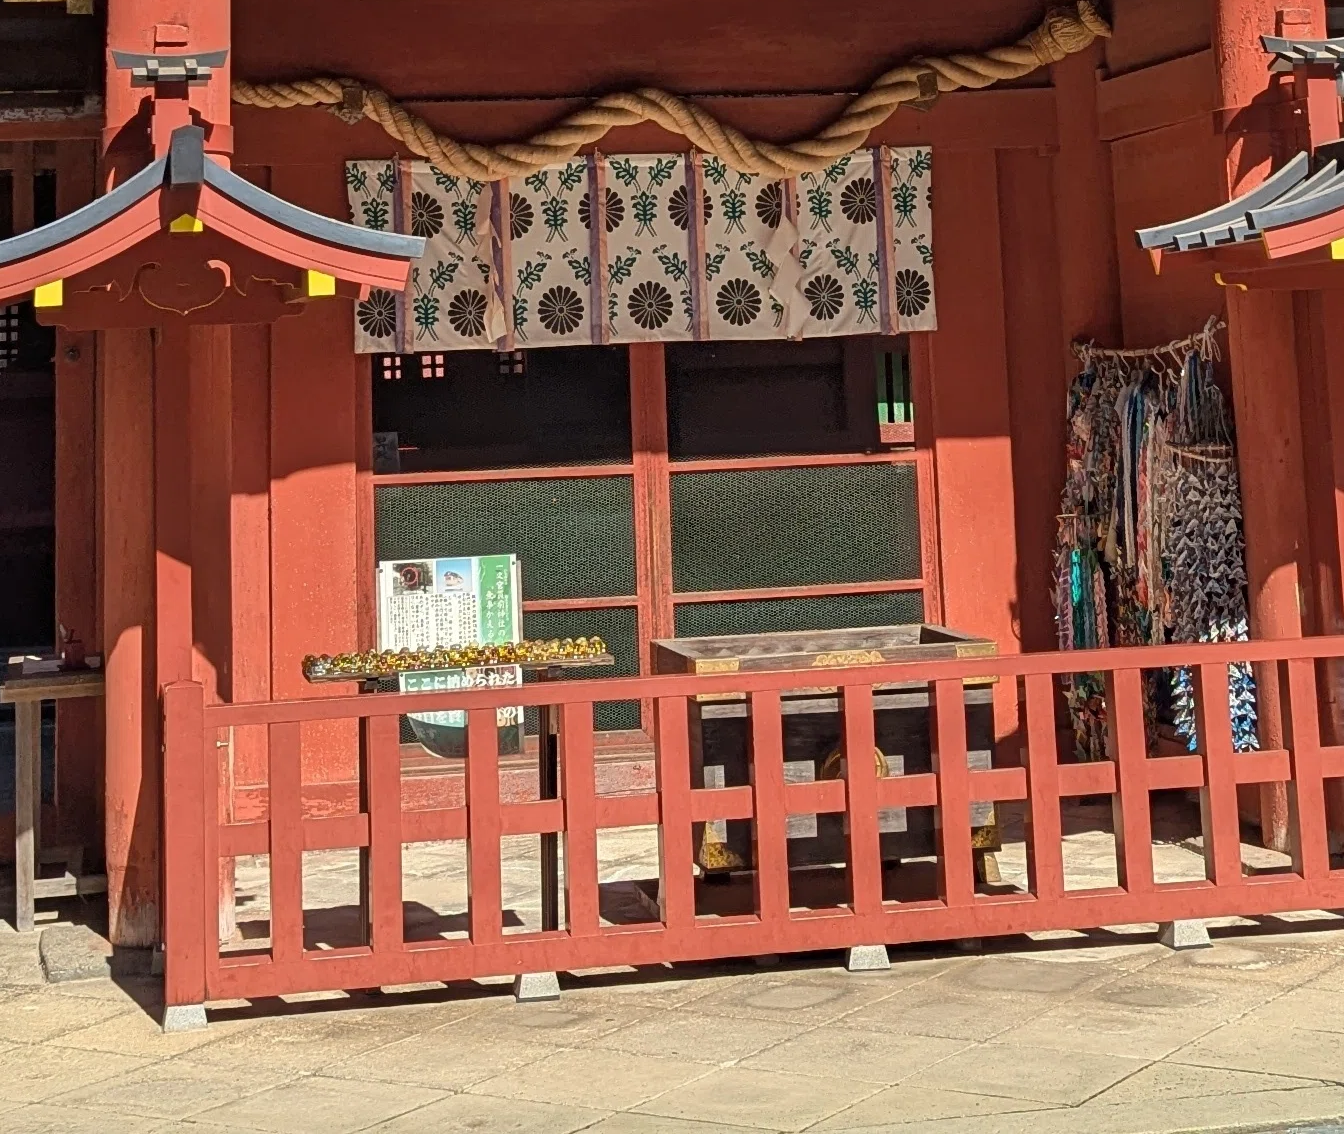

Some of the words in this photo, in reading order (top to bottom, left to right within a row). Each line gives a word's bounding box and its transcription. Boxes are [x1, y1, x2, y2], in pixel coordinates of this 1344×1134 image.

[407, 671, 515, 691] ここに納められた
